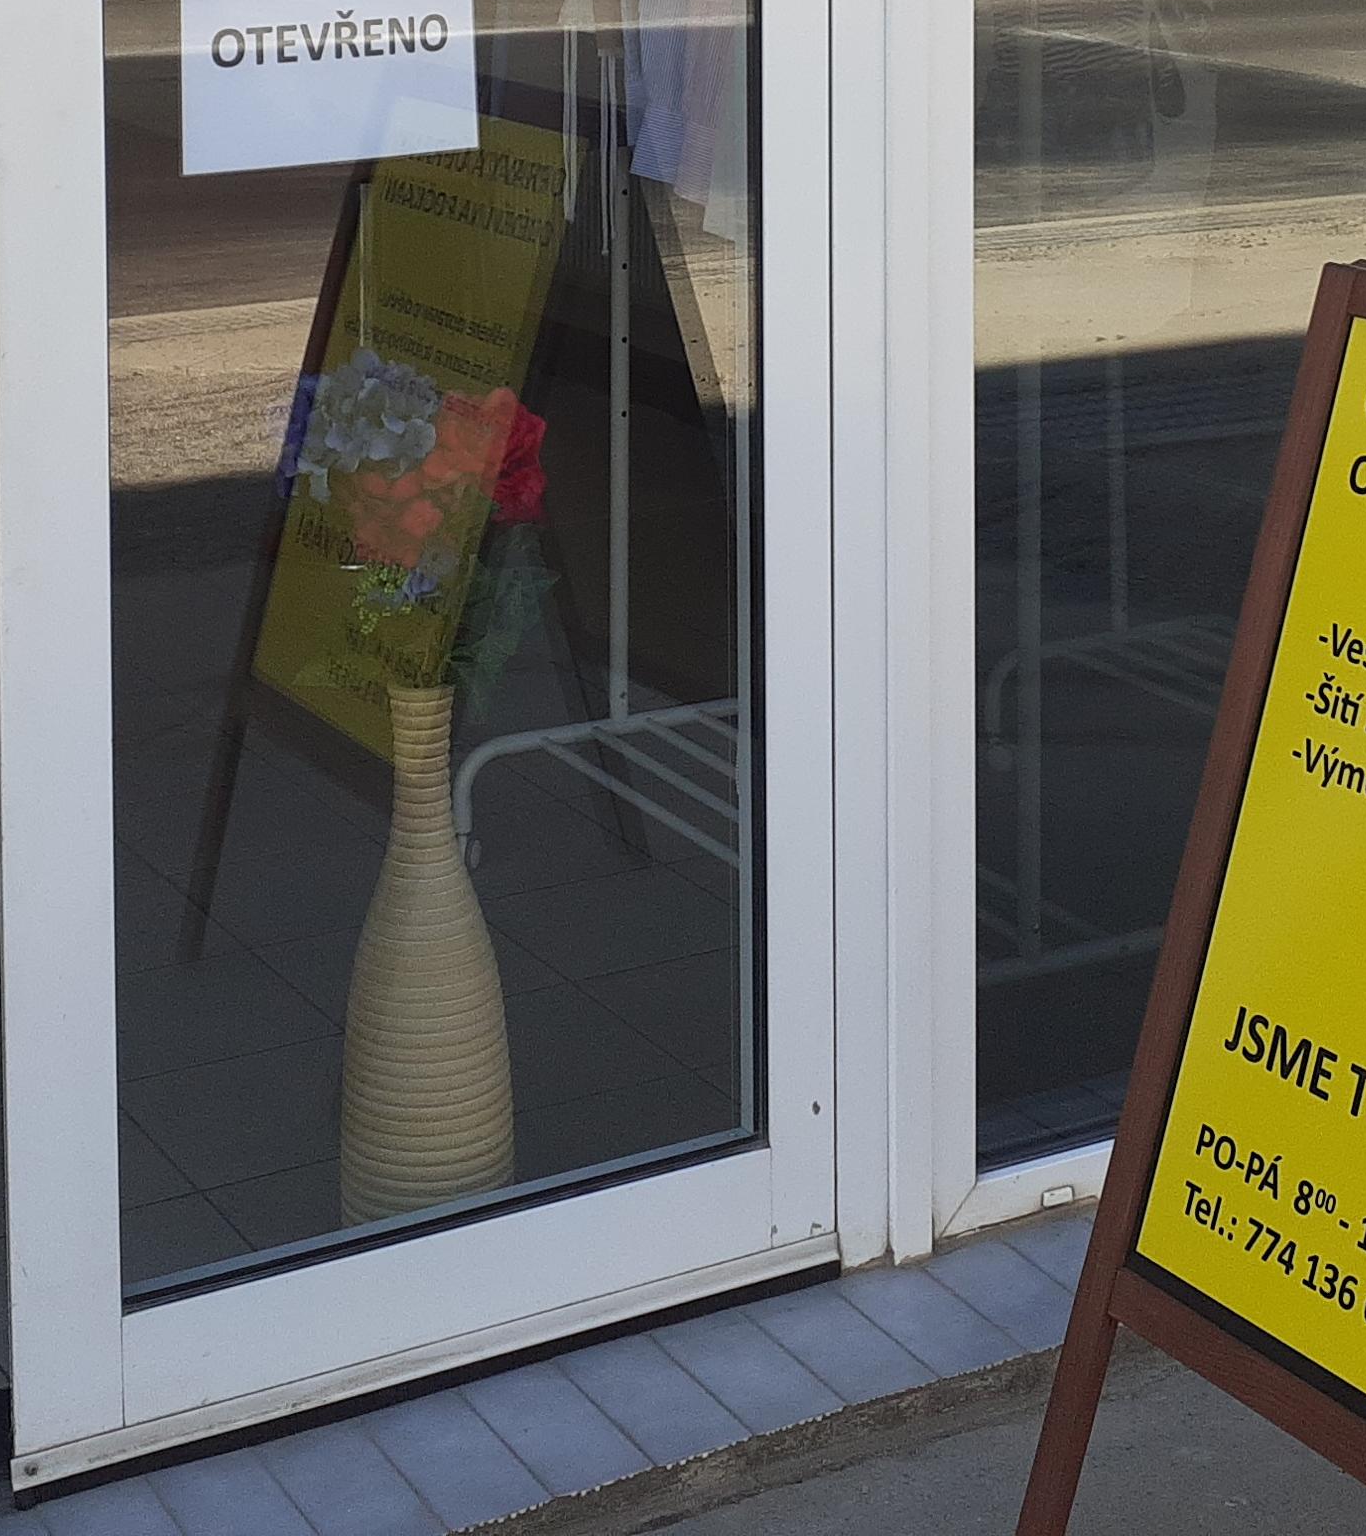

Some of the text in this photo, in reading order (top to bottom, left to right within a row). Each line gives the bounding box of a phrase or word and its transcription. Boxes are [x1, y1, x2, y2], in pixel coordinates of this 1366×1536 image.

[211, 9, 449, 68] OTEVŘENO
[1305, 672, 1364, 727] -Šití
[1223, 1006, 1338, 1102] JSME
[1195, 1123, 1283, 1200] PO-PÁ
[1182, 1180, 1236, 1242] Tel.:
[1242, 1216, 1296, 1276] 774
[1301, 1253, 1357, 1312] 136
